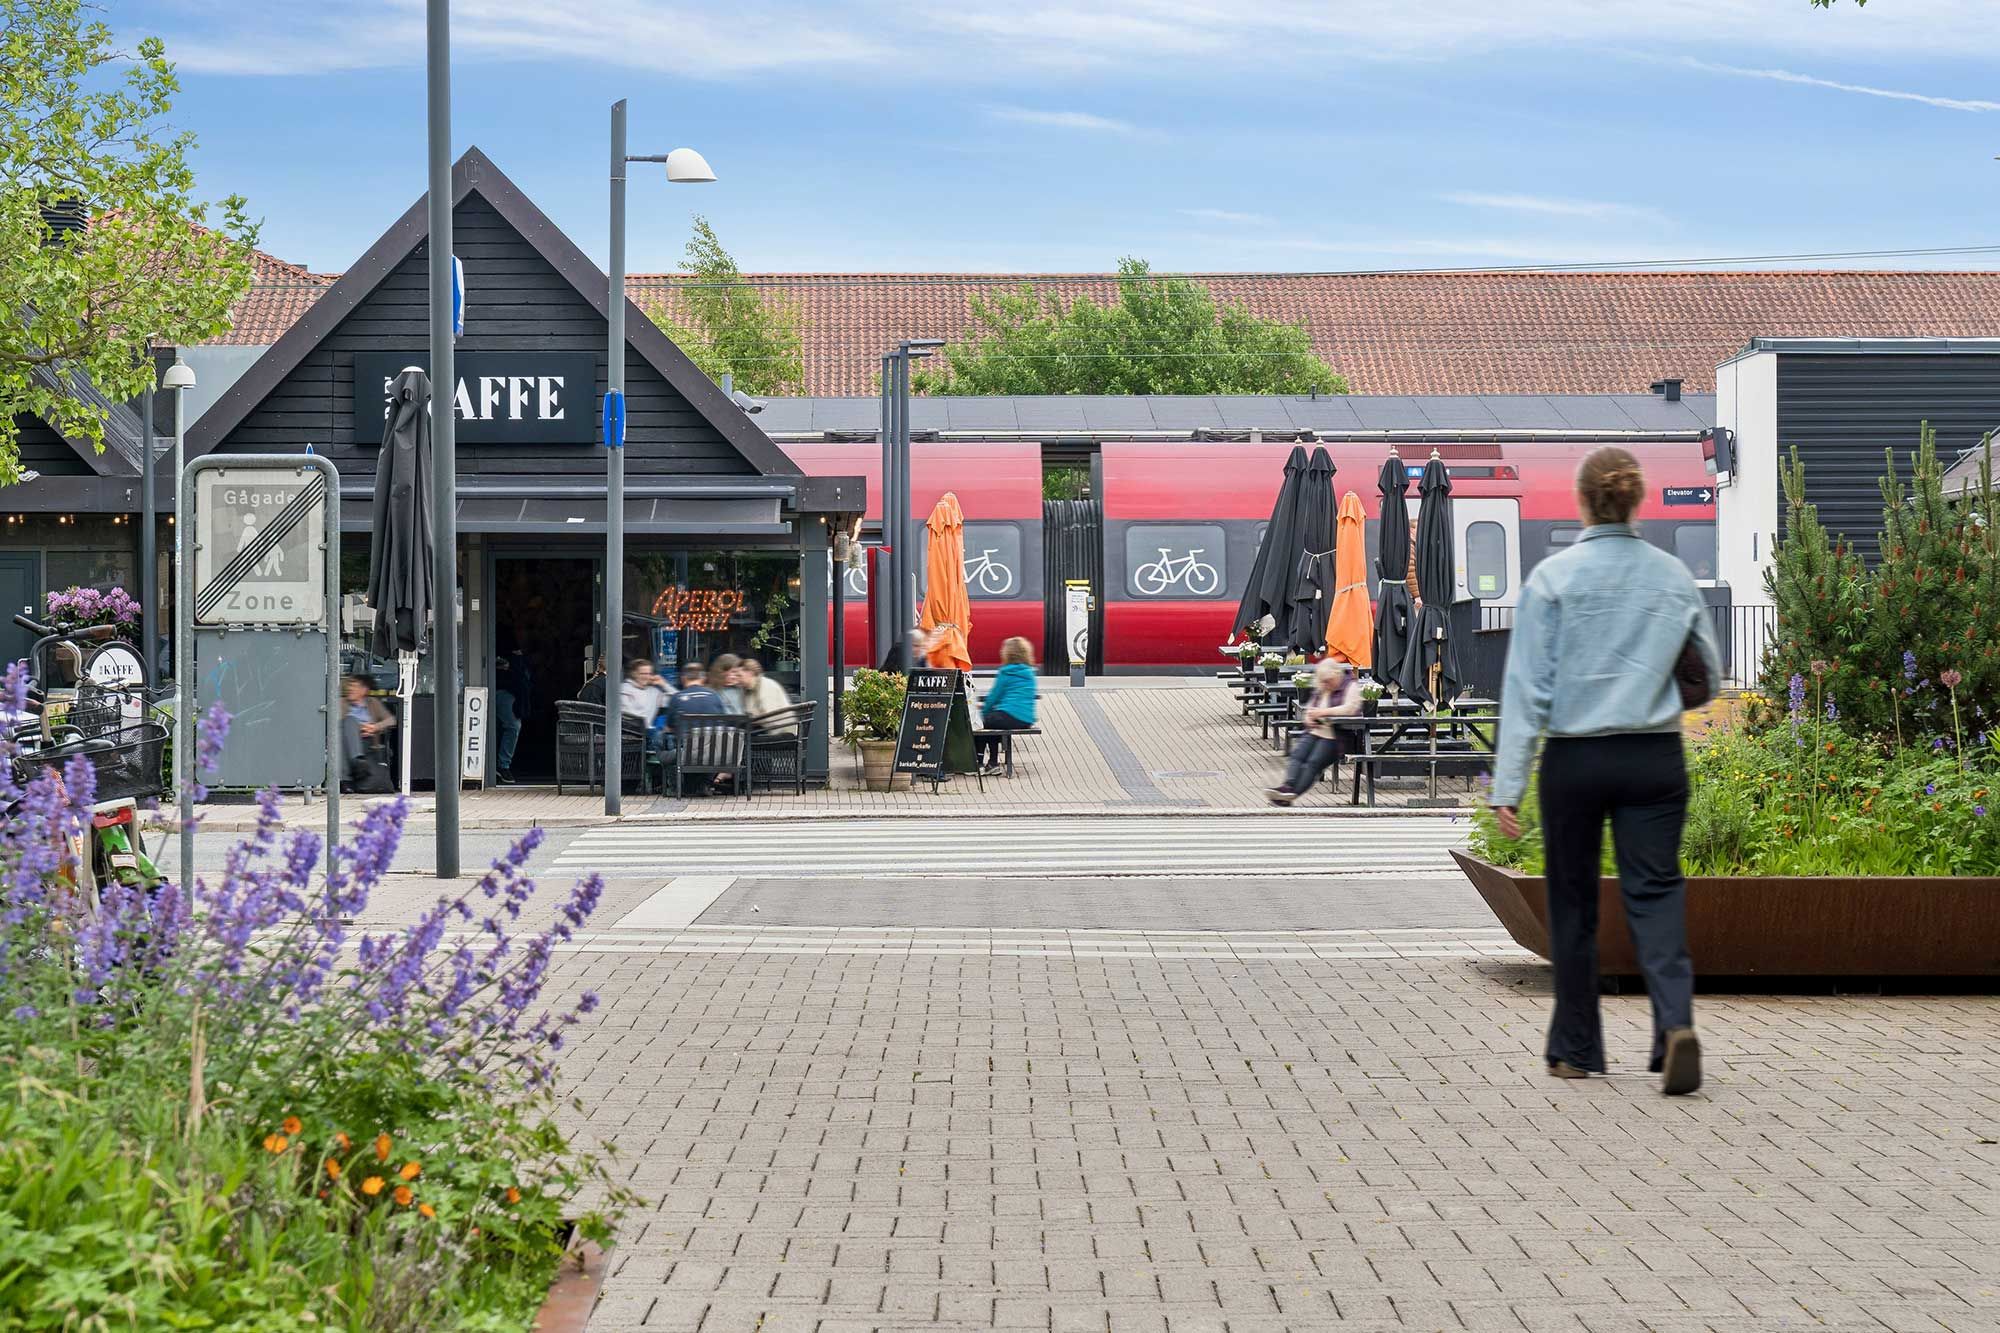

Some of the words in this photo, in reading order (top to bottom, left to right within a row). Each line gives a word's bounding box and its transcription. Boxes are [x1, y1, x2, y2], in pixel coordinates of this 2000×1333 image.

[428, 376, 565, 420] AFFE
[226, 590, 294, 610] Zone
[651, 584, 749, 615] APEROL
[918, 675, 948, 688] KAFFE
[467, 697, 482, 770] OPEN
